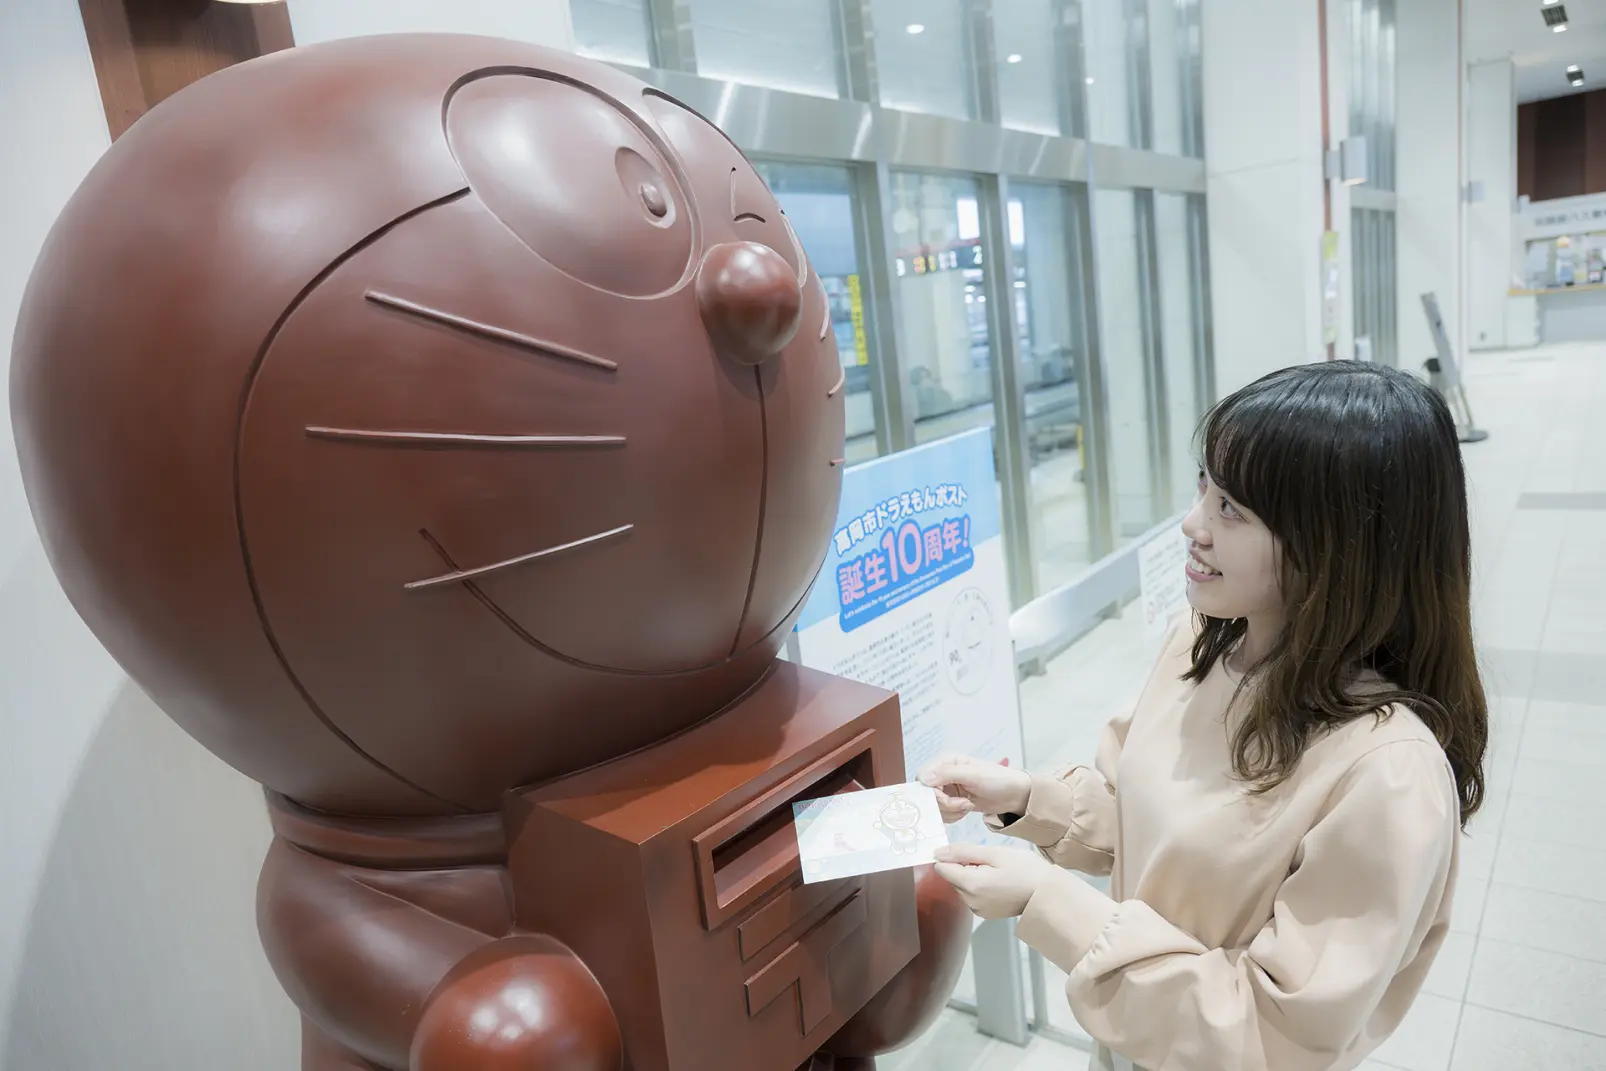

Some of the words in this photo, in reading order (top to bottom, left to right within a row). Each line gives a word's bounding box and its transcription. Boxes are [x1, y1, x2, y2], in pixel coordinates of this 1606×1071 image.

[833, 484, 968, 556] 高岡市ドラえもんポスト
